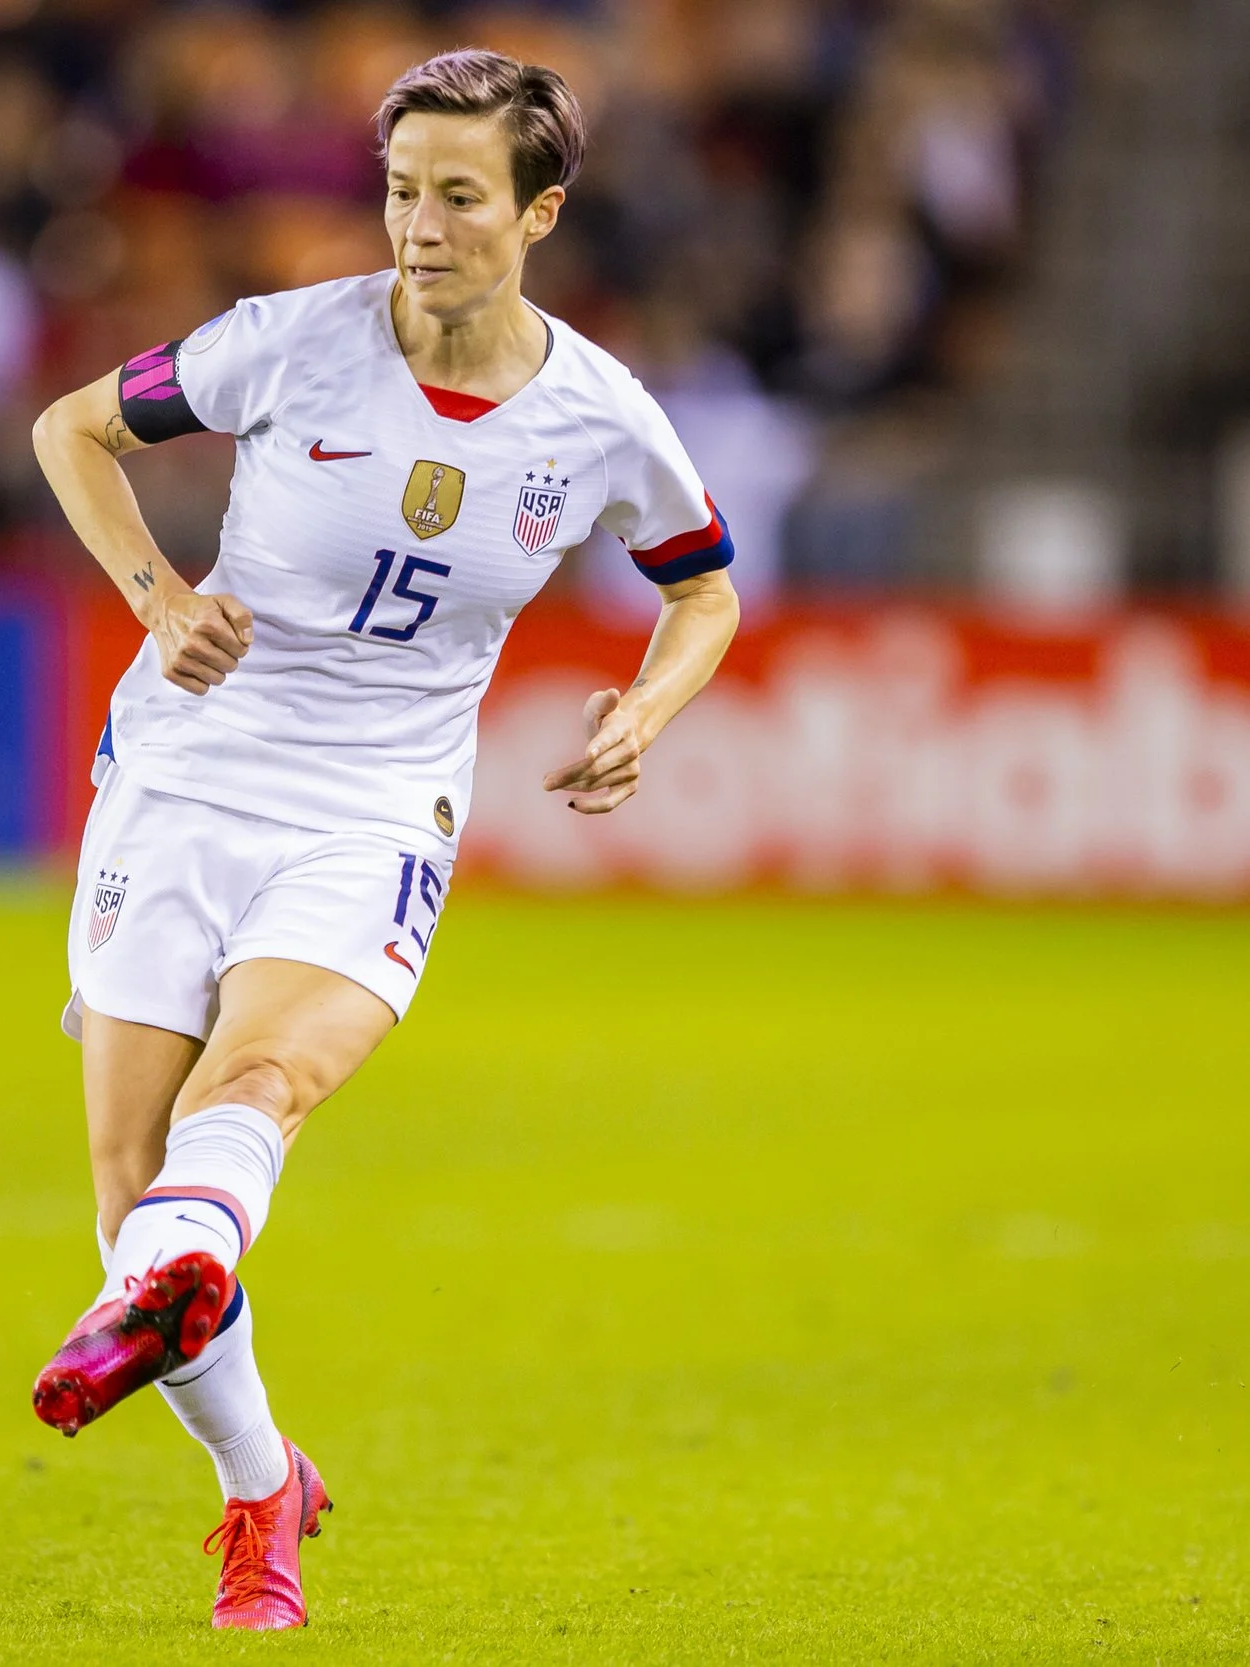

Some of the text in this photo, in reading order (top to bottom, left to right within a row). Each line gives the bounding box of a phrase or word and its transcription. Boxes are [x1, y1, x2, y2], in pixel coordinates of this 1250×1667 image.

[414, 508, 440, 524] FIFA
[523, 491, 561, 518] USA
[348, 548, 452, 642] 15
[95, 888, 121, 914] USA
